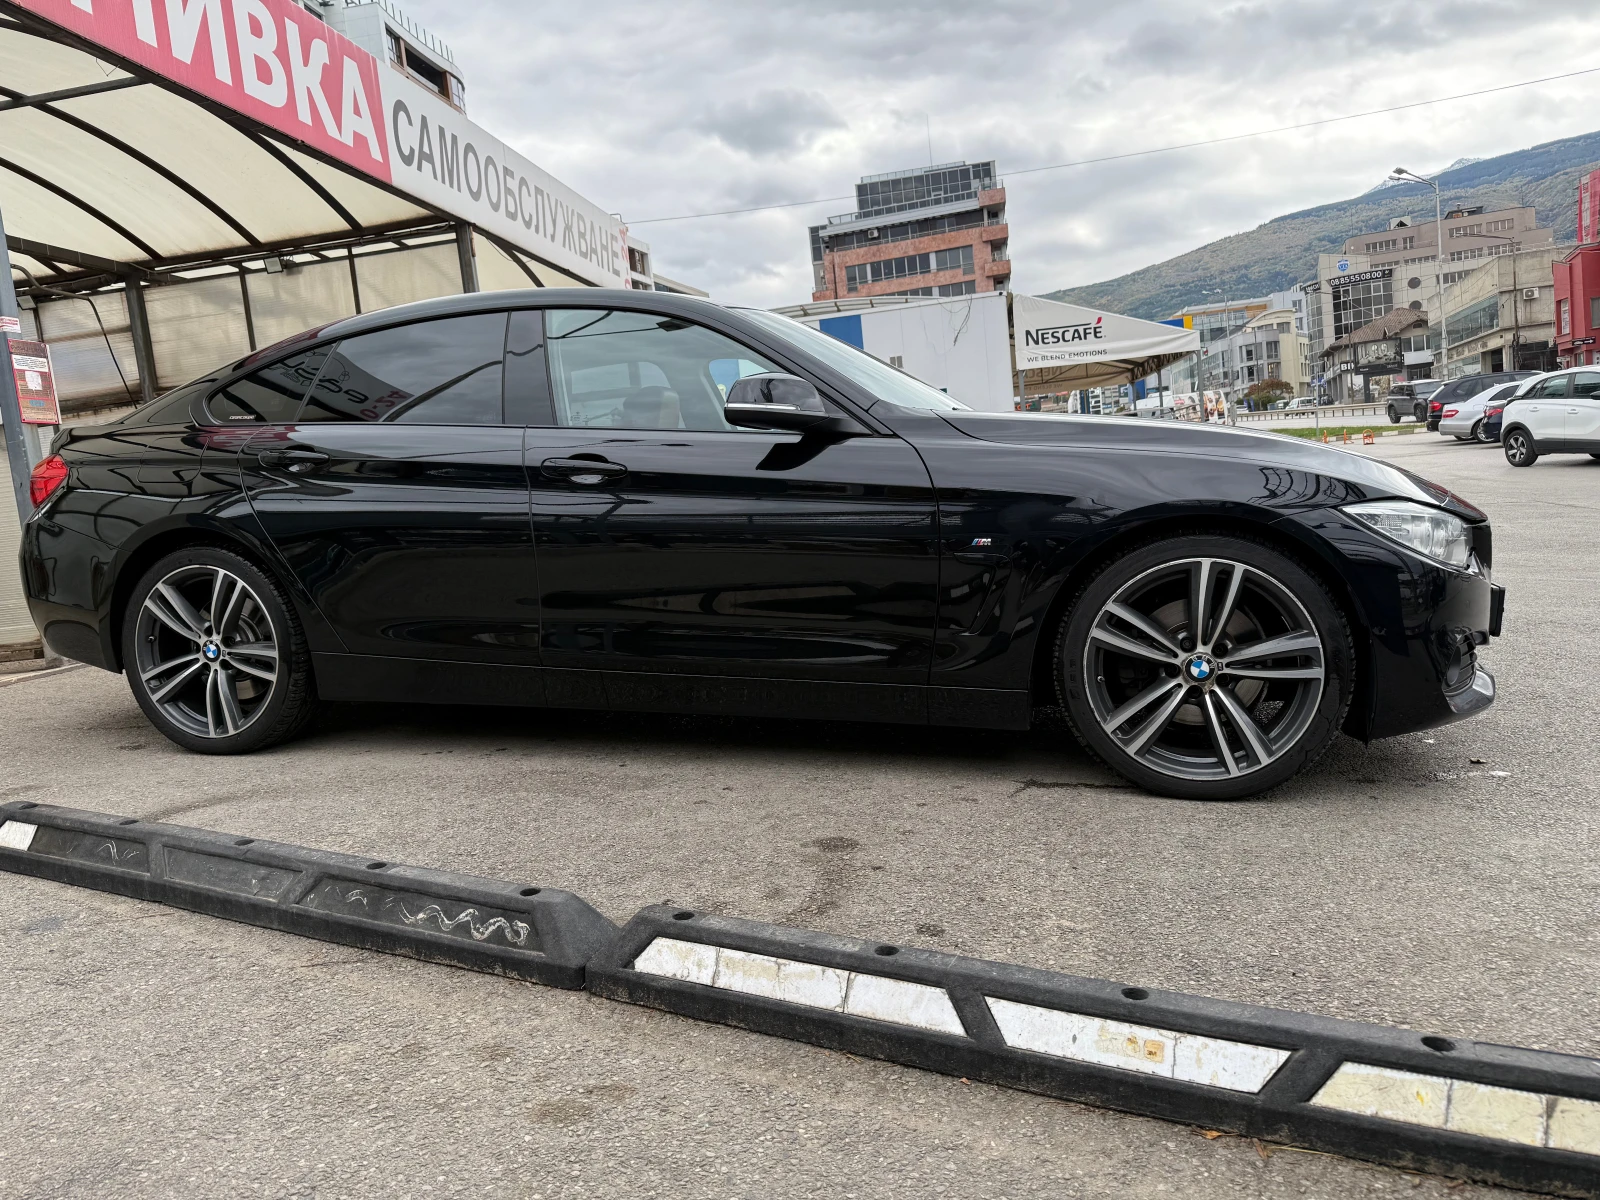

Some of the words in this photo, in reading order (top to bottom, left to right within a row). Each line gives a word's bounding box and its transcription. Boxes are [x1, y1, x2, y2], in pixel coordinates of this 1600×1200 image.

[70, 0, 384, 164] ИВКА
[392, 98, 621, 278] САМООБСЛУЖВАНЕ
[1025, 316, 1103, 346] NESCAFÉ
[1041, 353, 1066, 361] BLEND
[1068, 349, 1108, 359] EMOTIONS
